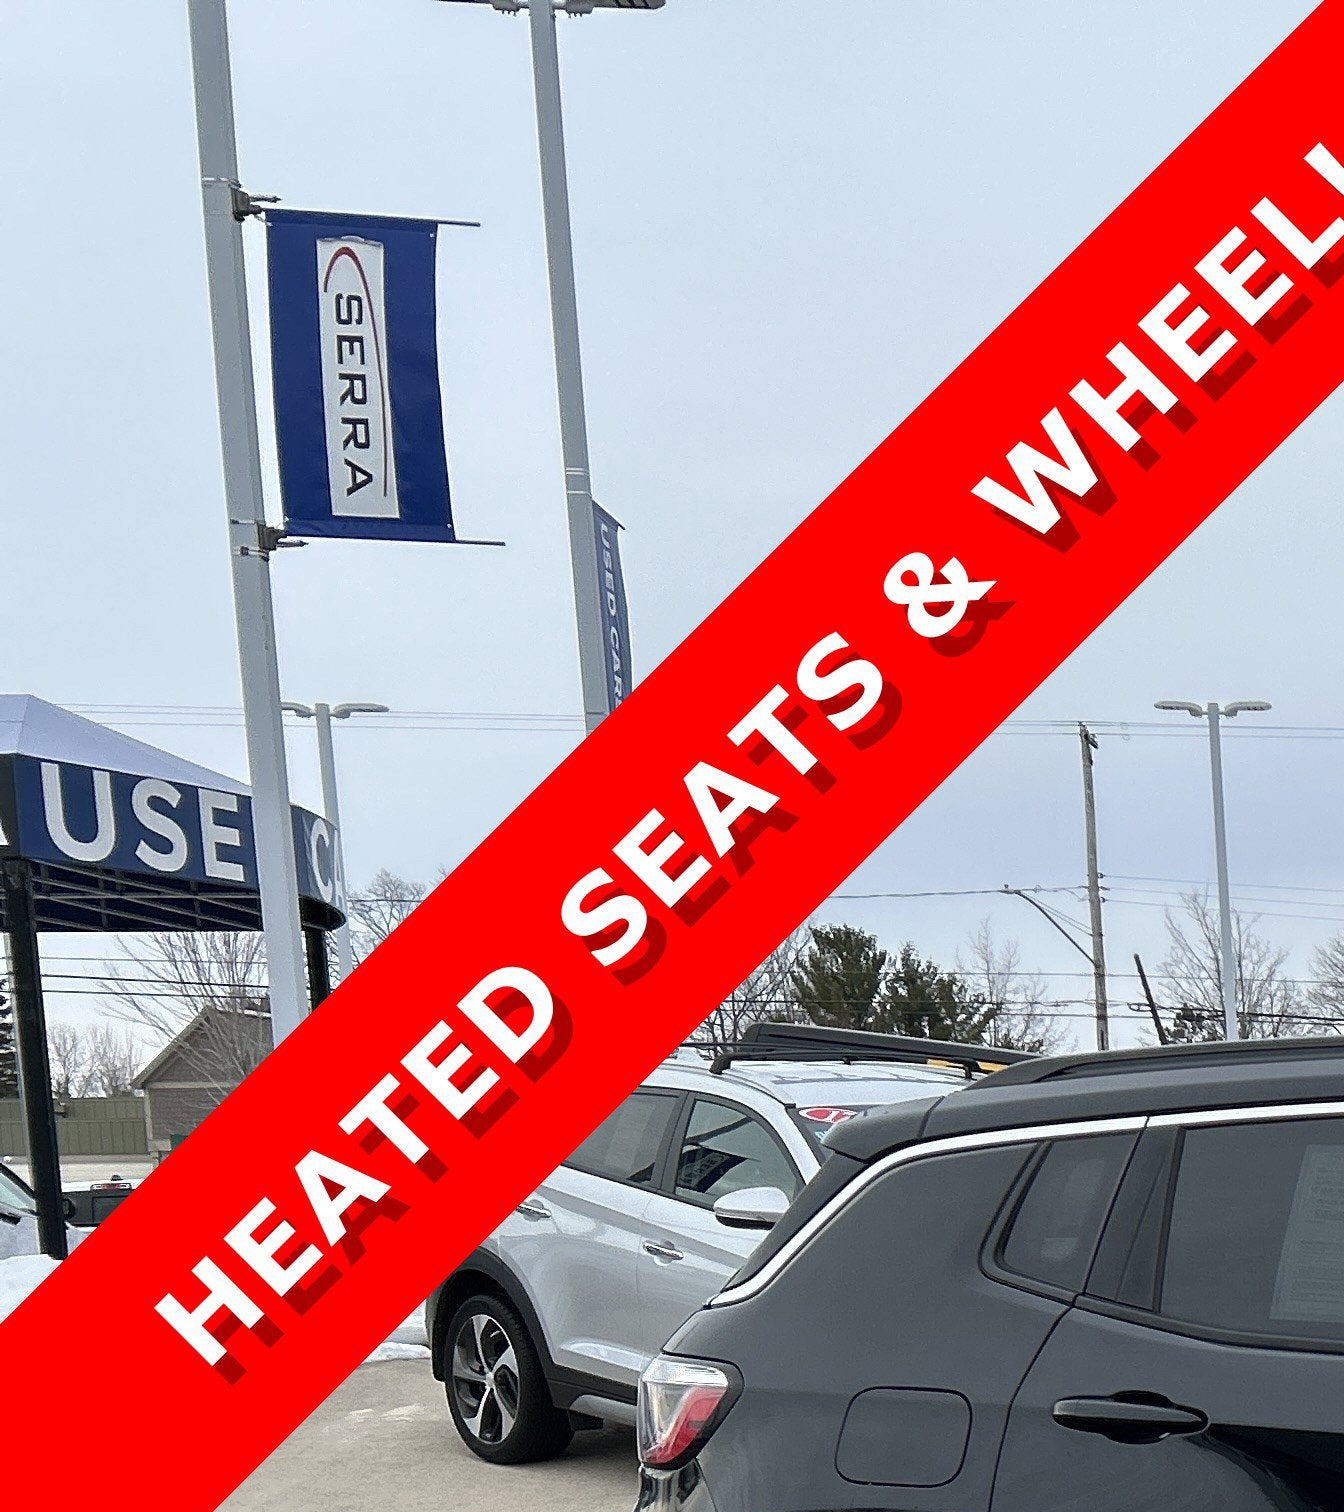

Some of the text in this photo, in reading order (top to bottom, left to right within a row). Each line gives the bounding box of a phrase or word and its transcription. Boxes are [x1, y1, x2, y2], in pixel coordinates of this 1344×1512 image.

[334, 292, 374, 498] SERRA
[600, 522, 618, 617] USED
[39, 761, 246, 883] USE
